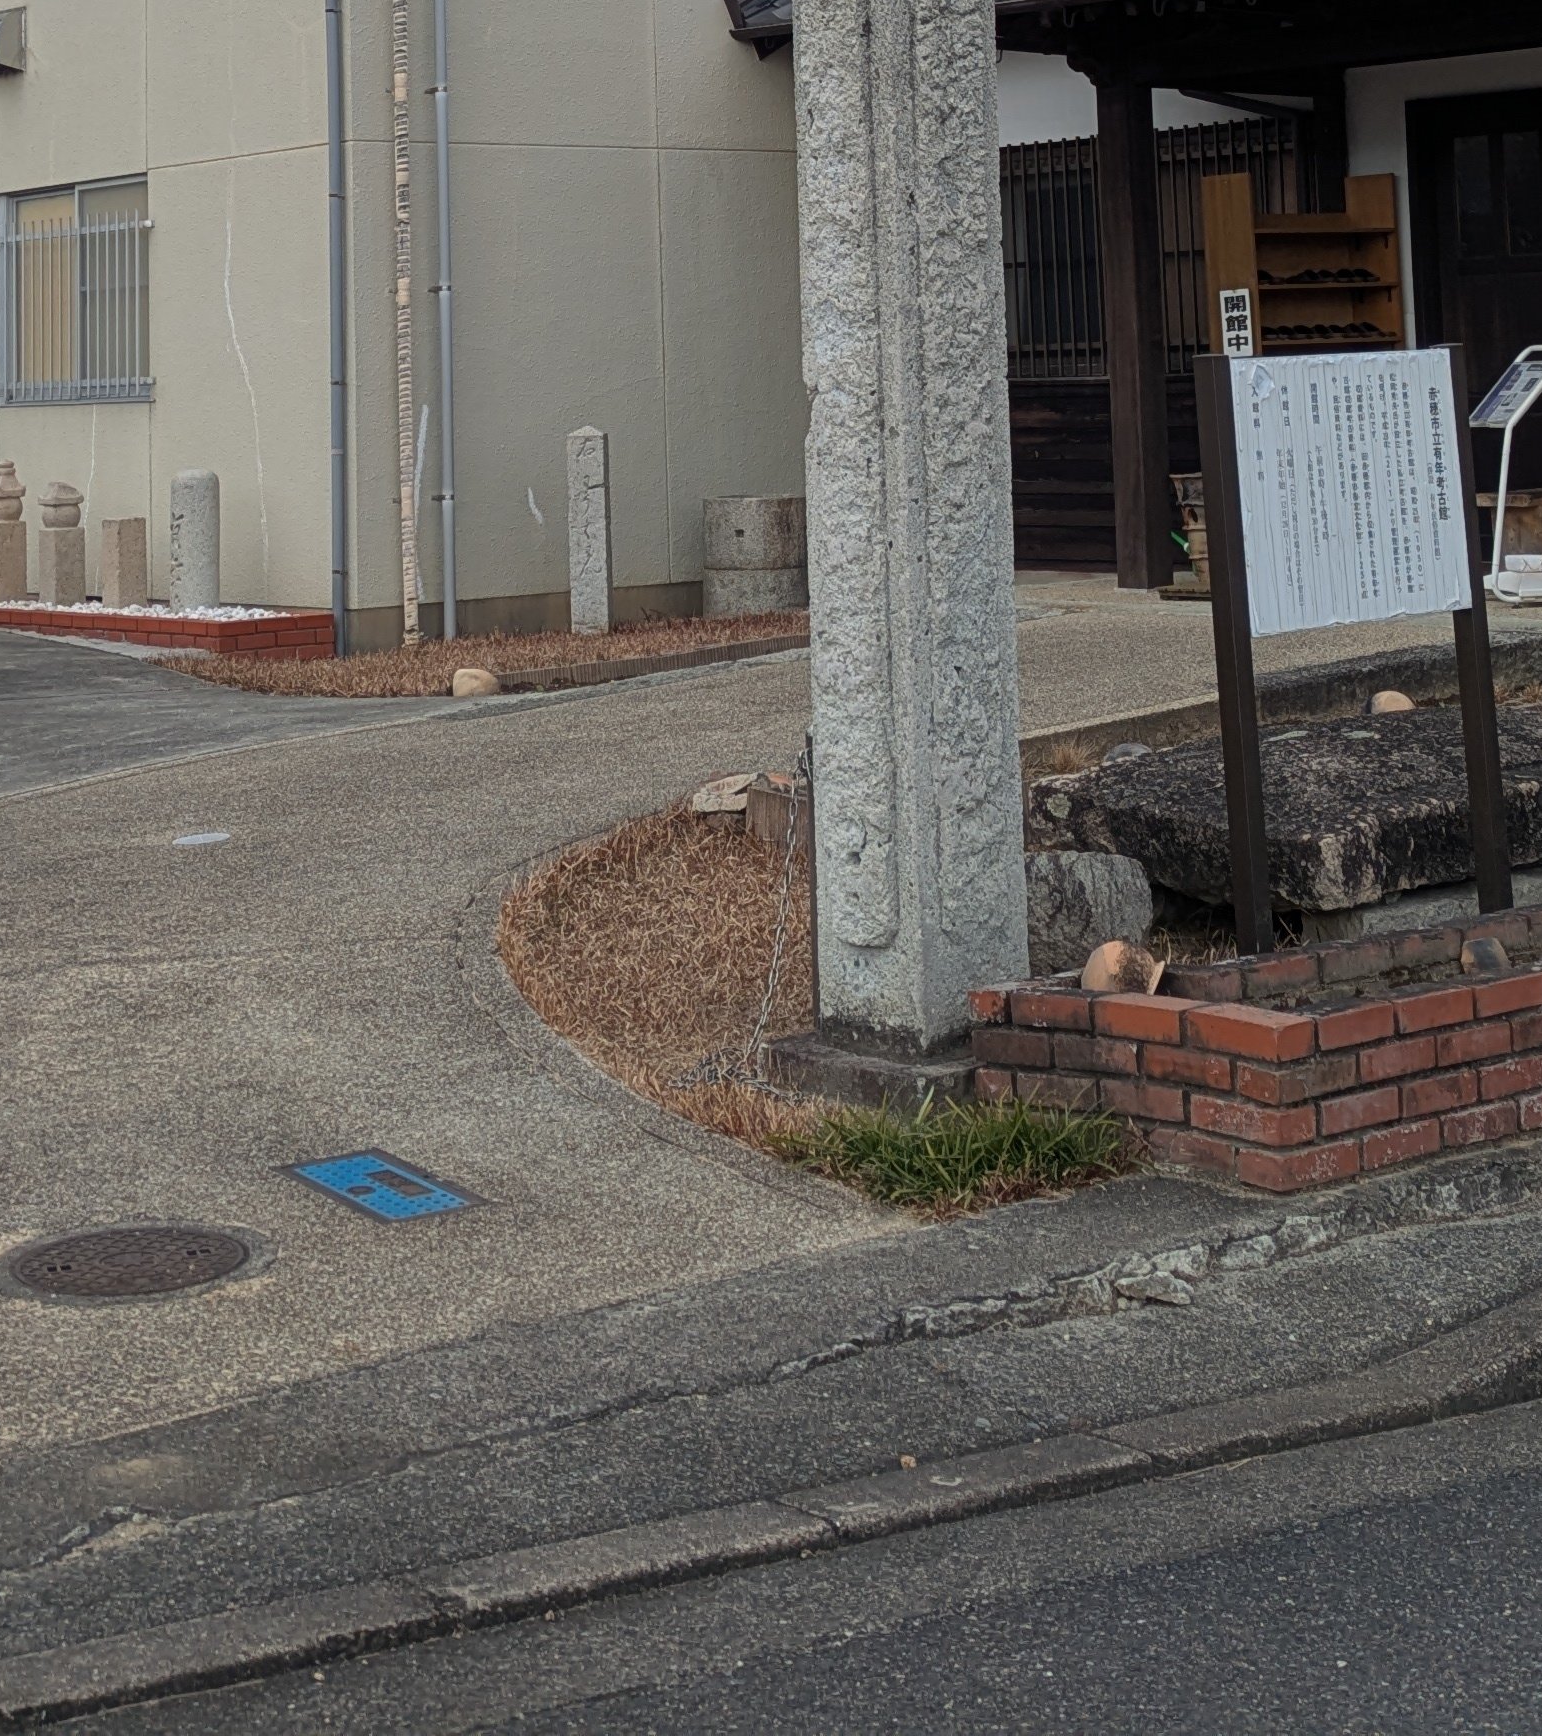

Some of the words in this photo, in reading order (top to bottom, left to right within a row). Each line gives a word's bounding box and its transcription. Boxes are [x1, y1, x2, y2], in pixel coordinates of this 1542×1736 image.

[1224, 295, 1248, 351] 開館中
[1428, 387, 1448, 521] 赤穂市立有年考古館
